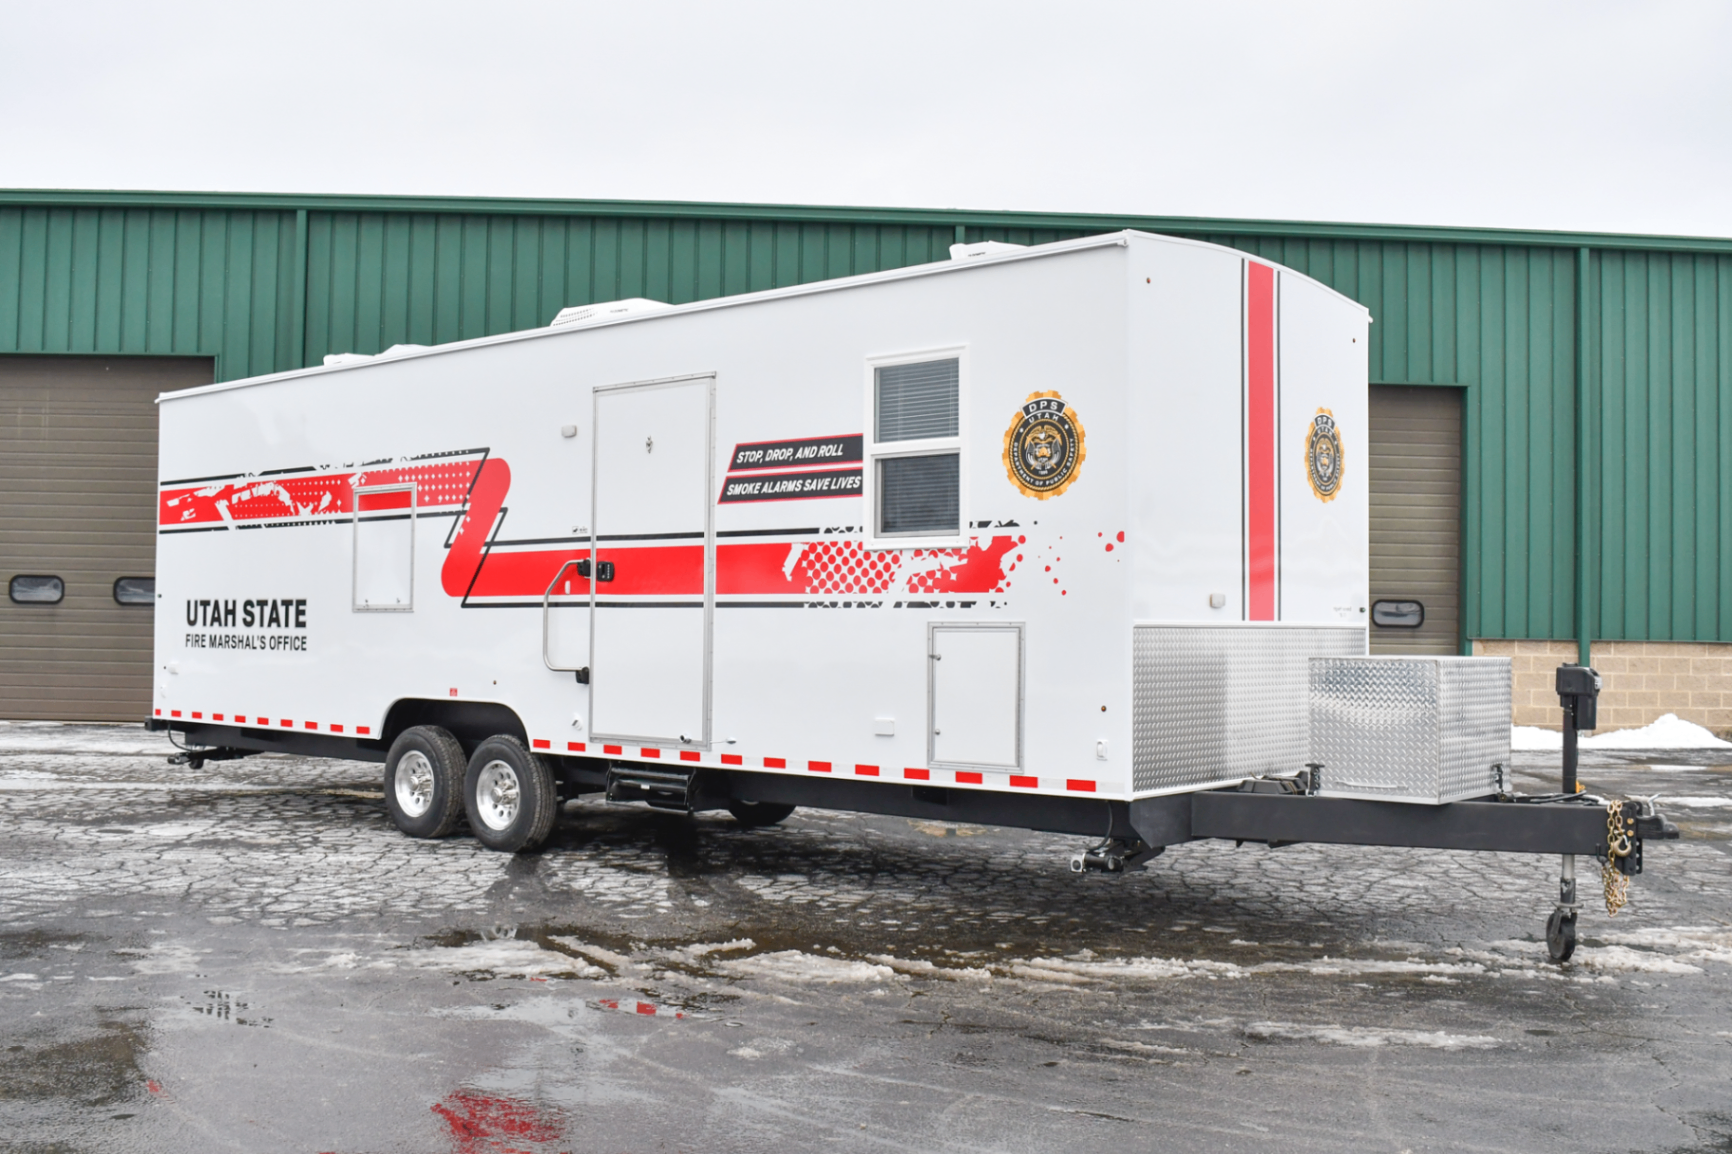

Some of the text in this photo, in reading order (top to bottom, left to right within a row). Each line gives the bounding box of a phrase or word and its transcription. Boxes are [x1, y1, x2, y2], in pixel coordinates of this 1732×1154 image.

[1029, 401, 1058, 412] DPS
[1029, 412, 1059, 423] UTAH
[736, 444, 843, 464] STOP, DROP, AND ROLL
[1013, 442, 1033, 483] DEPARTMENT
[1046, 467, 1068, 485] PUBLIC
[1066, 438, 1075, 467] SAFETY
[726, 476, 861, 495] SMOKE ALARMS SAVE LIVES
[187, 599, 307, 628] UTAH STATE
[185, 634, 307, 651] FIRE MARSHAL'S OFFICE
